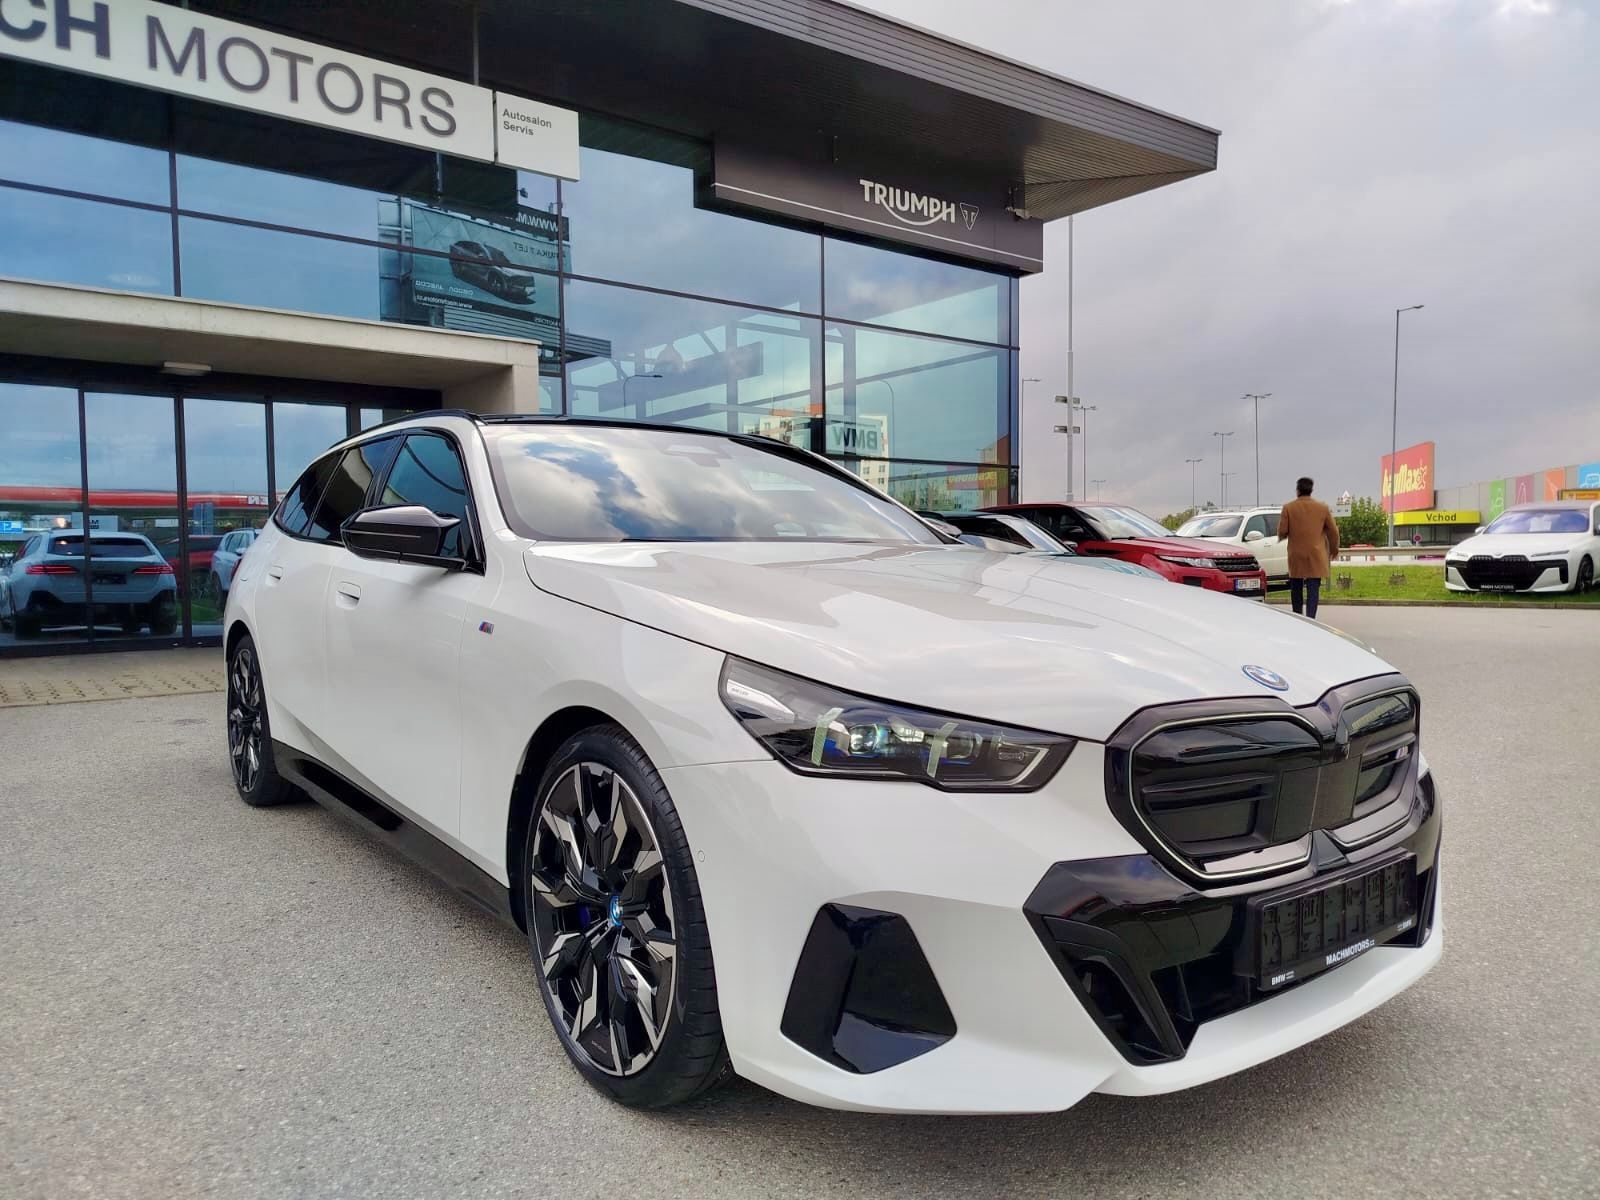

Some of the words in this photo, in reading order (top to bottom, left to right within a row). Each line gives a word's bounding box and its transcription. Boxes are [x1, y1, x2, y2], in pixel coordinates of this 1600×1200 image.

[147, 15, 457, 137] MOTORS
[502, 108, 552, 128] Autosalon
[503, 120, 534, 135] Servis
[860, 179, 955, 226] TRIUMPH
[1426, 513, 1457, 522] Vchod
